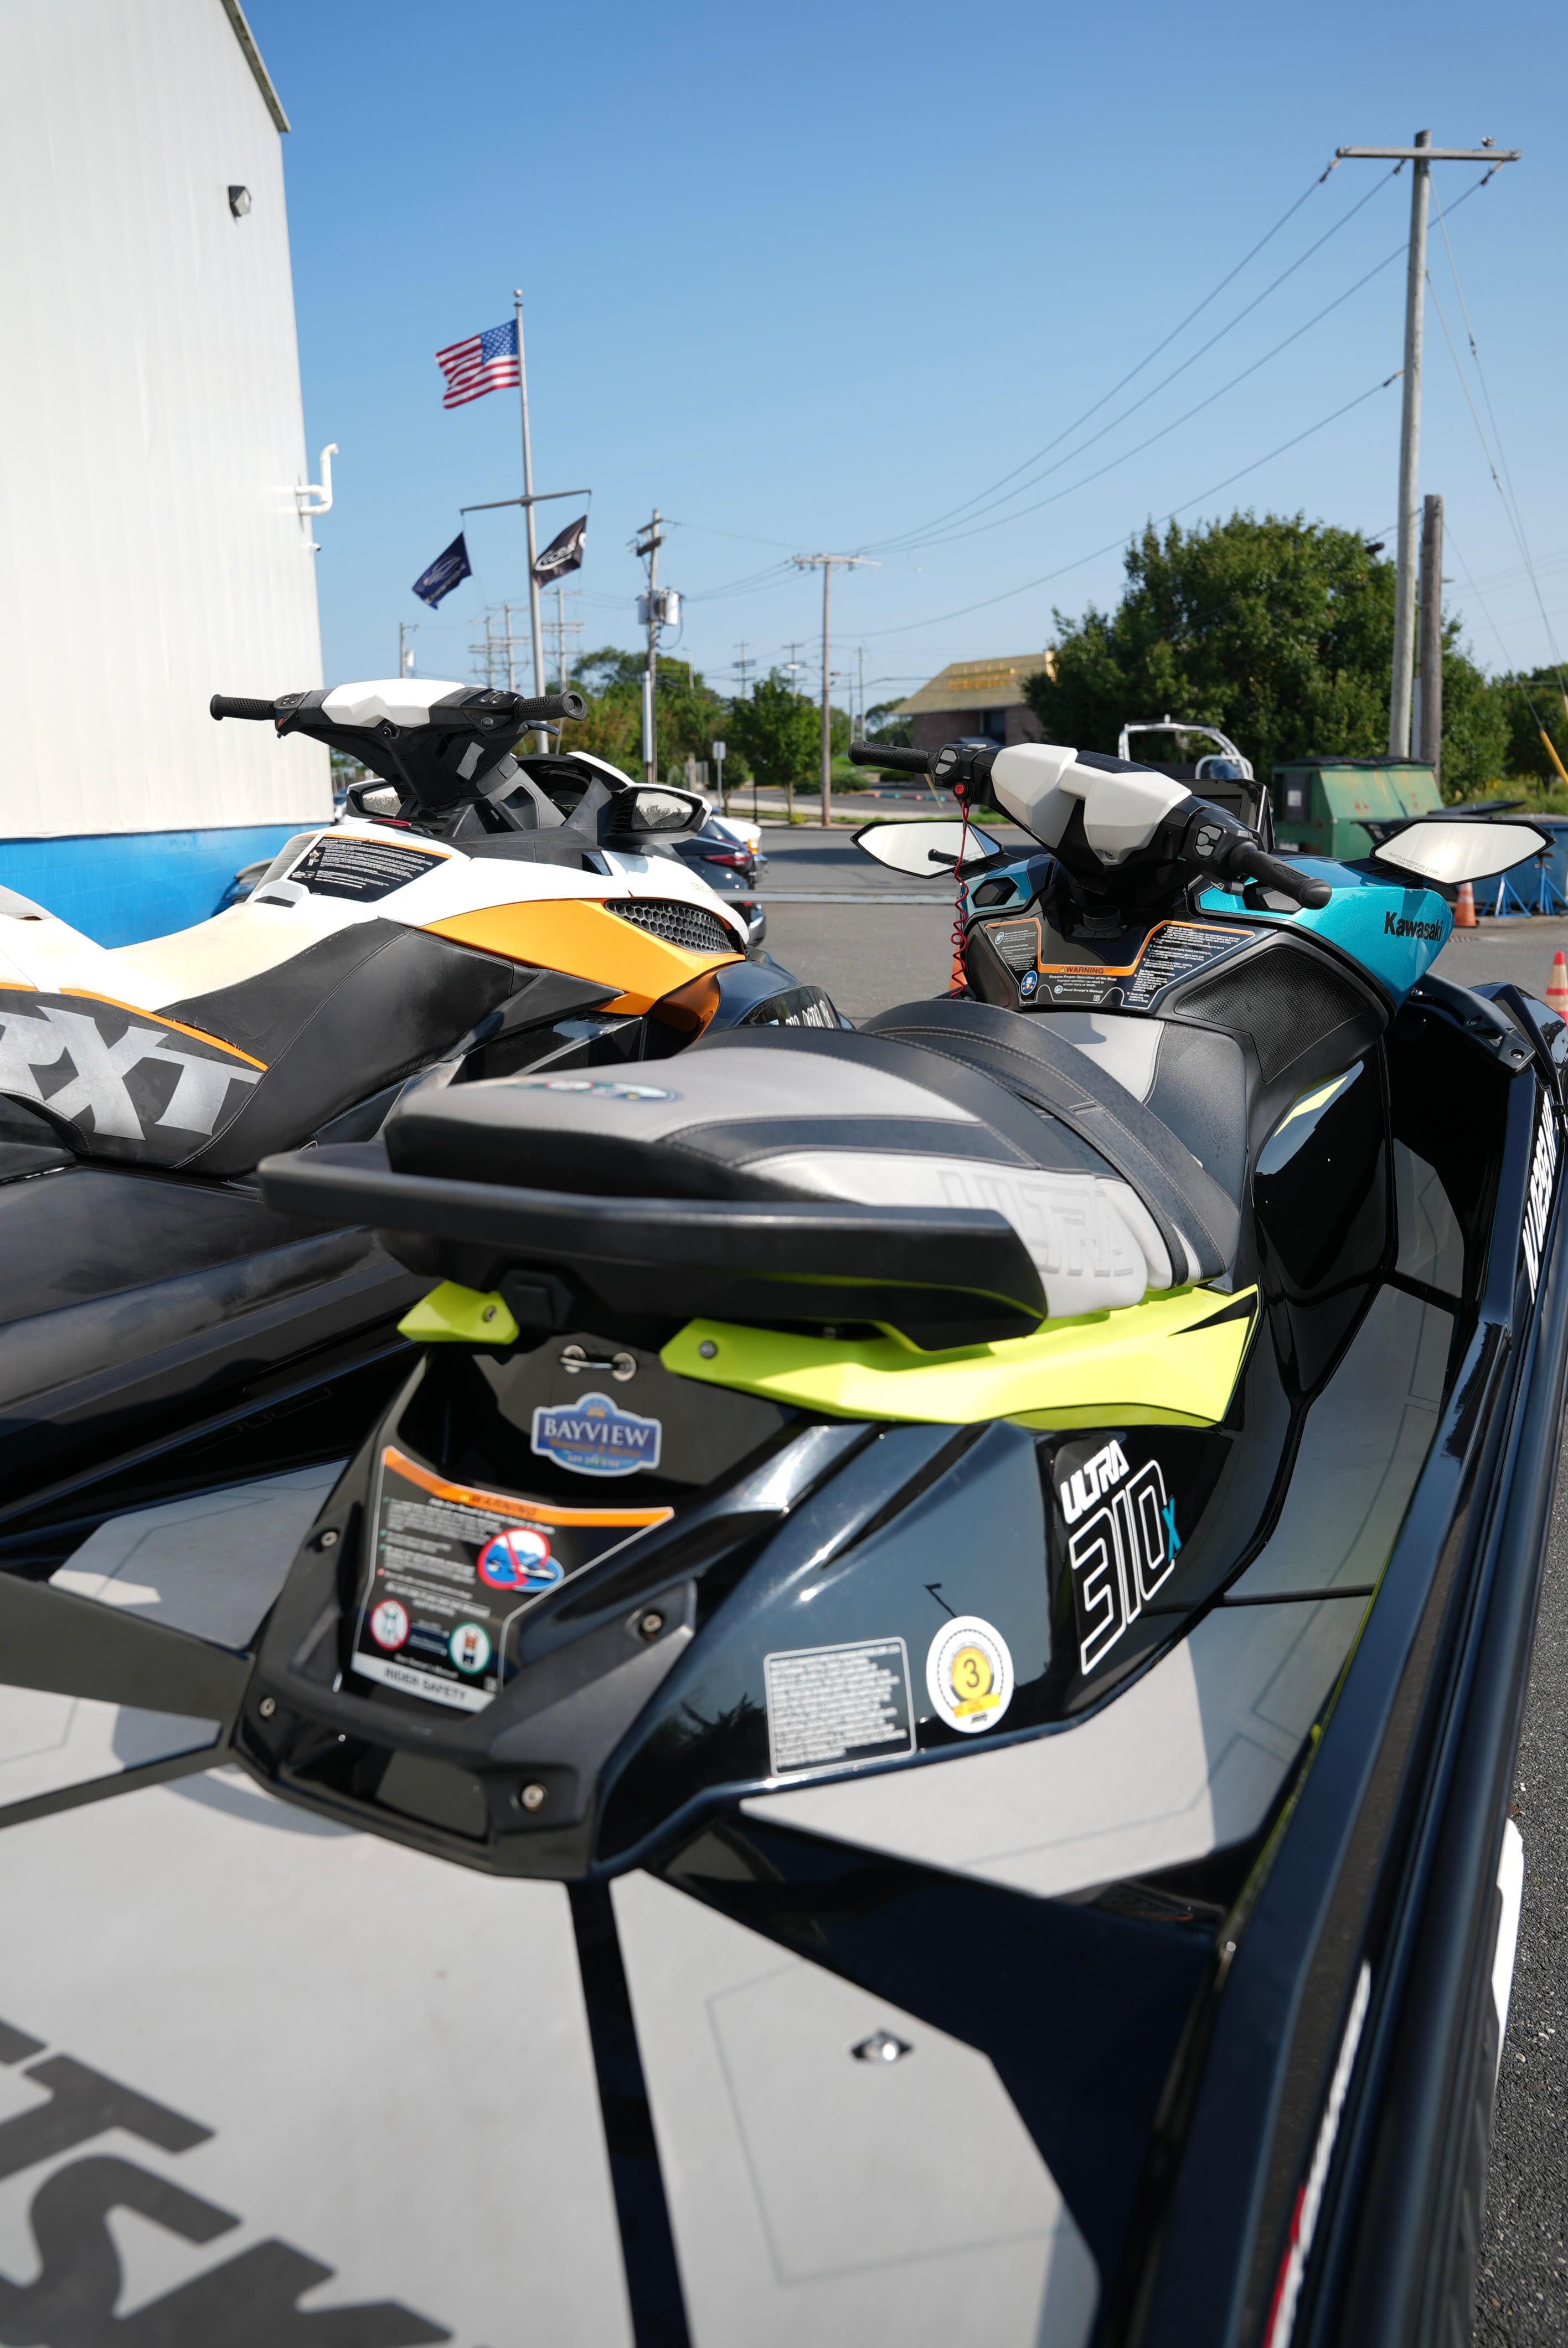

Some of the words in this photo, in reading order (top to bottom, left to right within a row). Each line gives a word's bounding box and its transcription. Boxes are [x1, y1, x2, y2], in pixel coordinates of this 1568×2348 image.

[1384, 911, 1443, 941] Kawasaki
[1523, 1200, 1539, 1305] NJ
[543, 1417, 651, 1448] BAYVIEW
[1060, 1439, 1131, 1525] ULTRA
[384, 1666, 420, 1686] RIDER
[422, 1677, 467, 1701] SAFETY
[964, 1658, 979, 1688] 3
